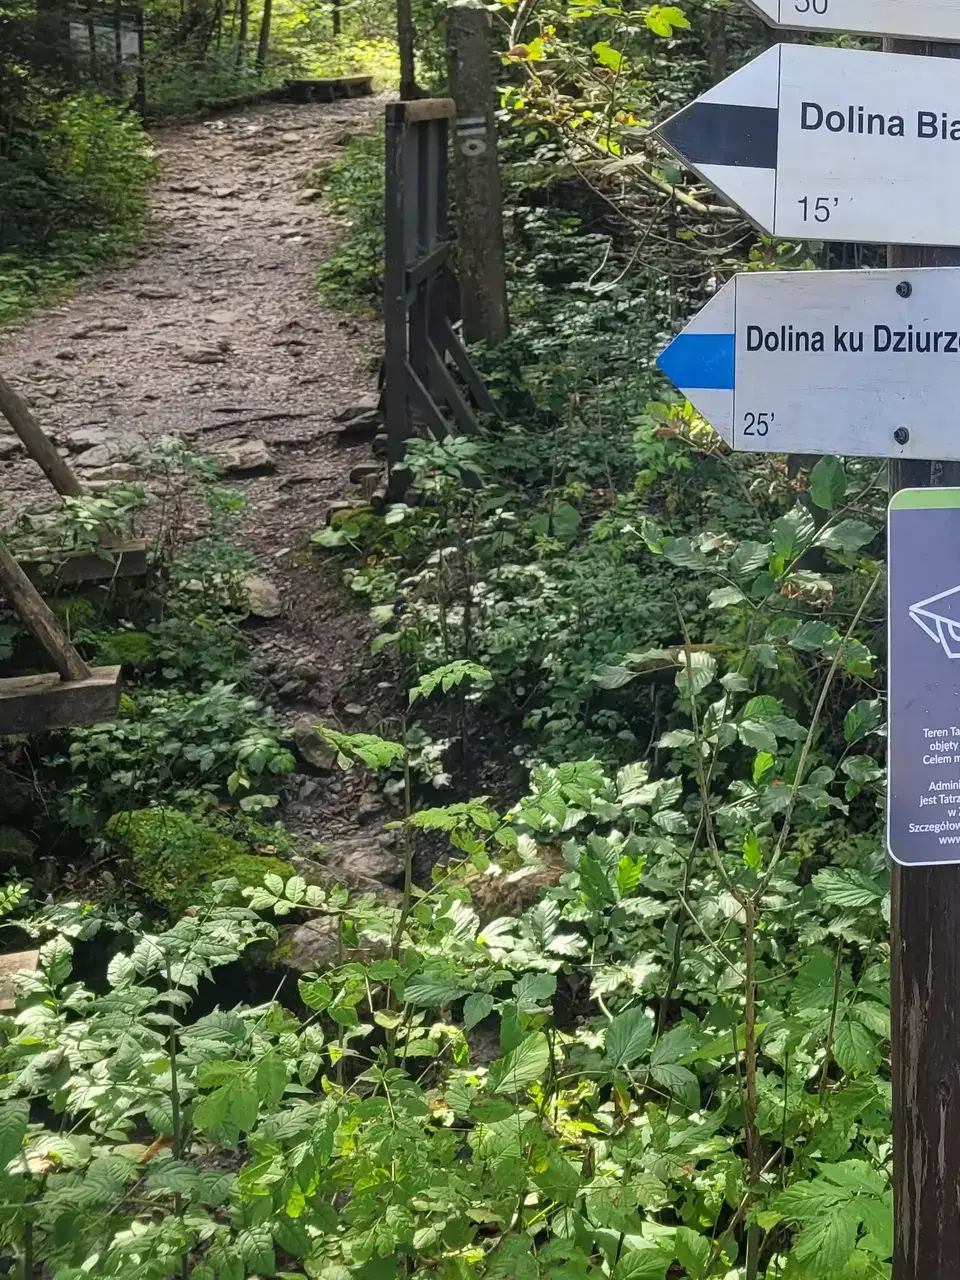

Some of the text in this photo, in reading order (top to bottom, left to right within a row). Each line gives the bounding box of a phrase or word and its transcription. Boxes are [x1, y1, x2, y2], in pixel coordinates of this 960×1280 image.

[801, 102, 904, 137] Dolina
[746, 325, 825, 353] Dolina
[834, 326, 864, 352] ku
[923, 728, 948, 738] Teren
[930, 740, 958, 751] objęty
[923, 755, 952, 764] Celem
[919, 796, 937, 807] jest
[948, 809, 957, 817] w
